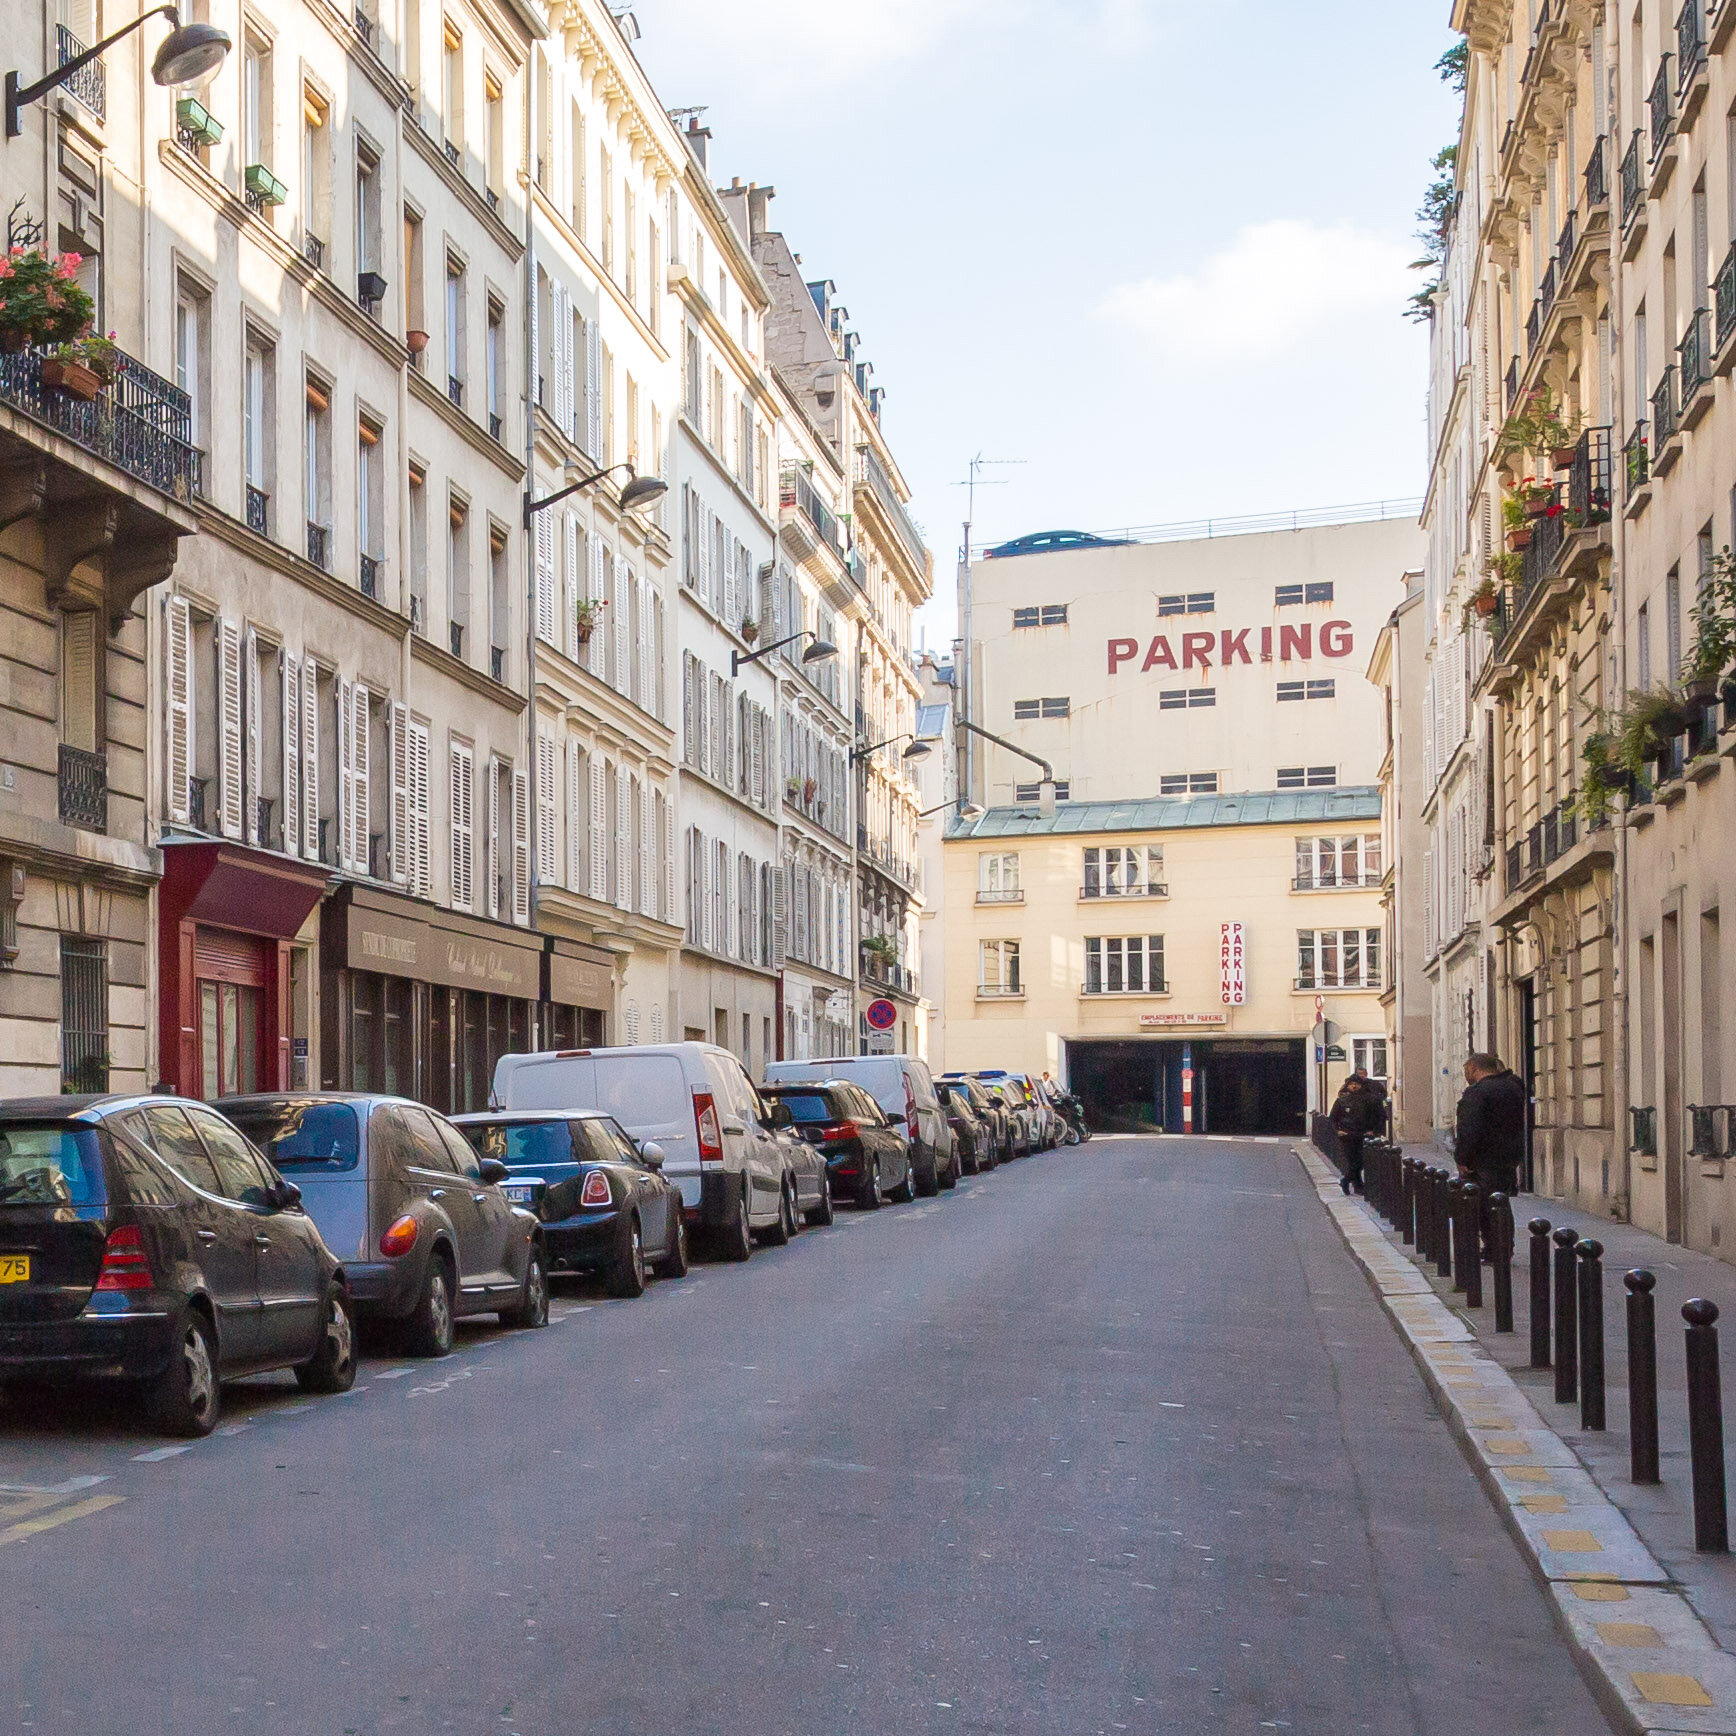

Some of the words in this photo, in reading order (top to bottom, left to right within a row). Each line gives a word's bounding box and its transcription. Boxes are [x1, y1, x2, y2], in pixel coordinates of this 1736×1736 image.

[1108, 620, 1354, 675] PARKING
[1221, 923, 1231, 1004] PARKING
[1233, 923, 1243, 1004] PARKING
[3, 1259, 27, 1276] 75
